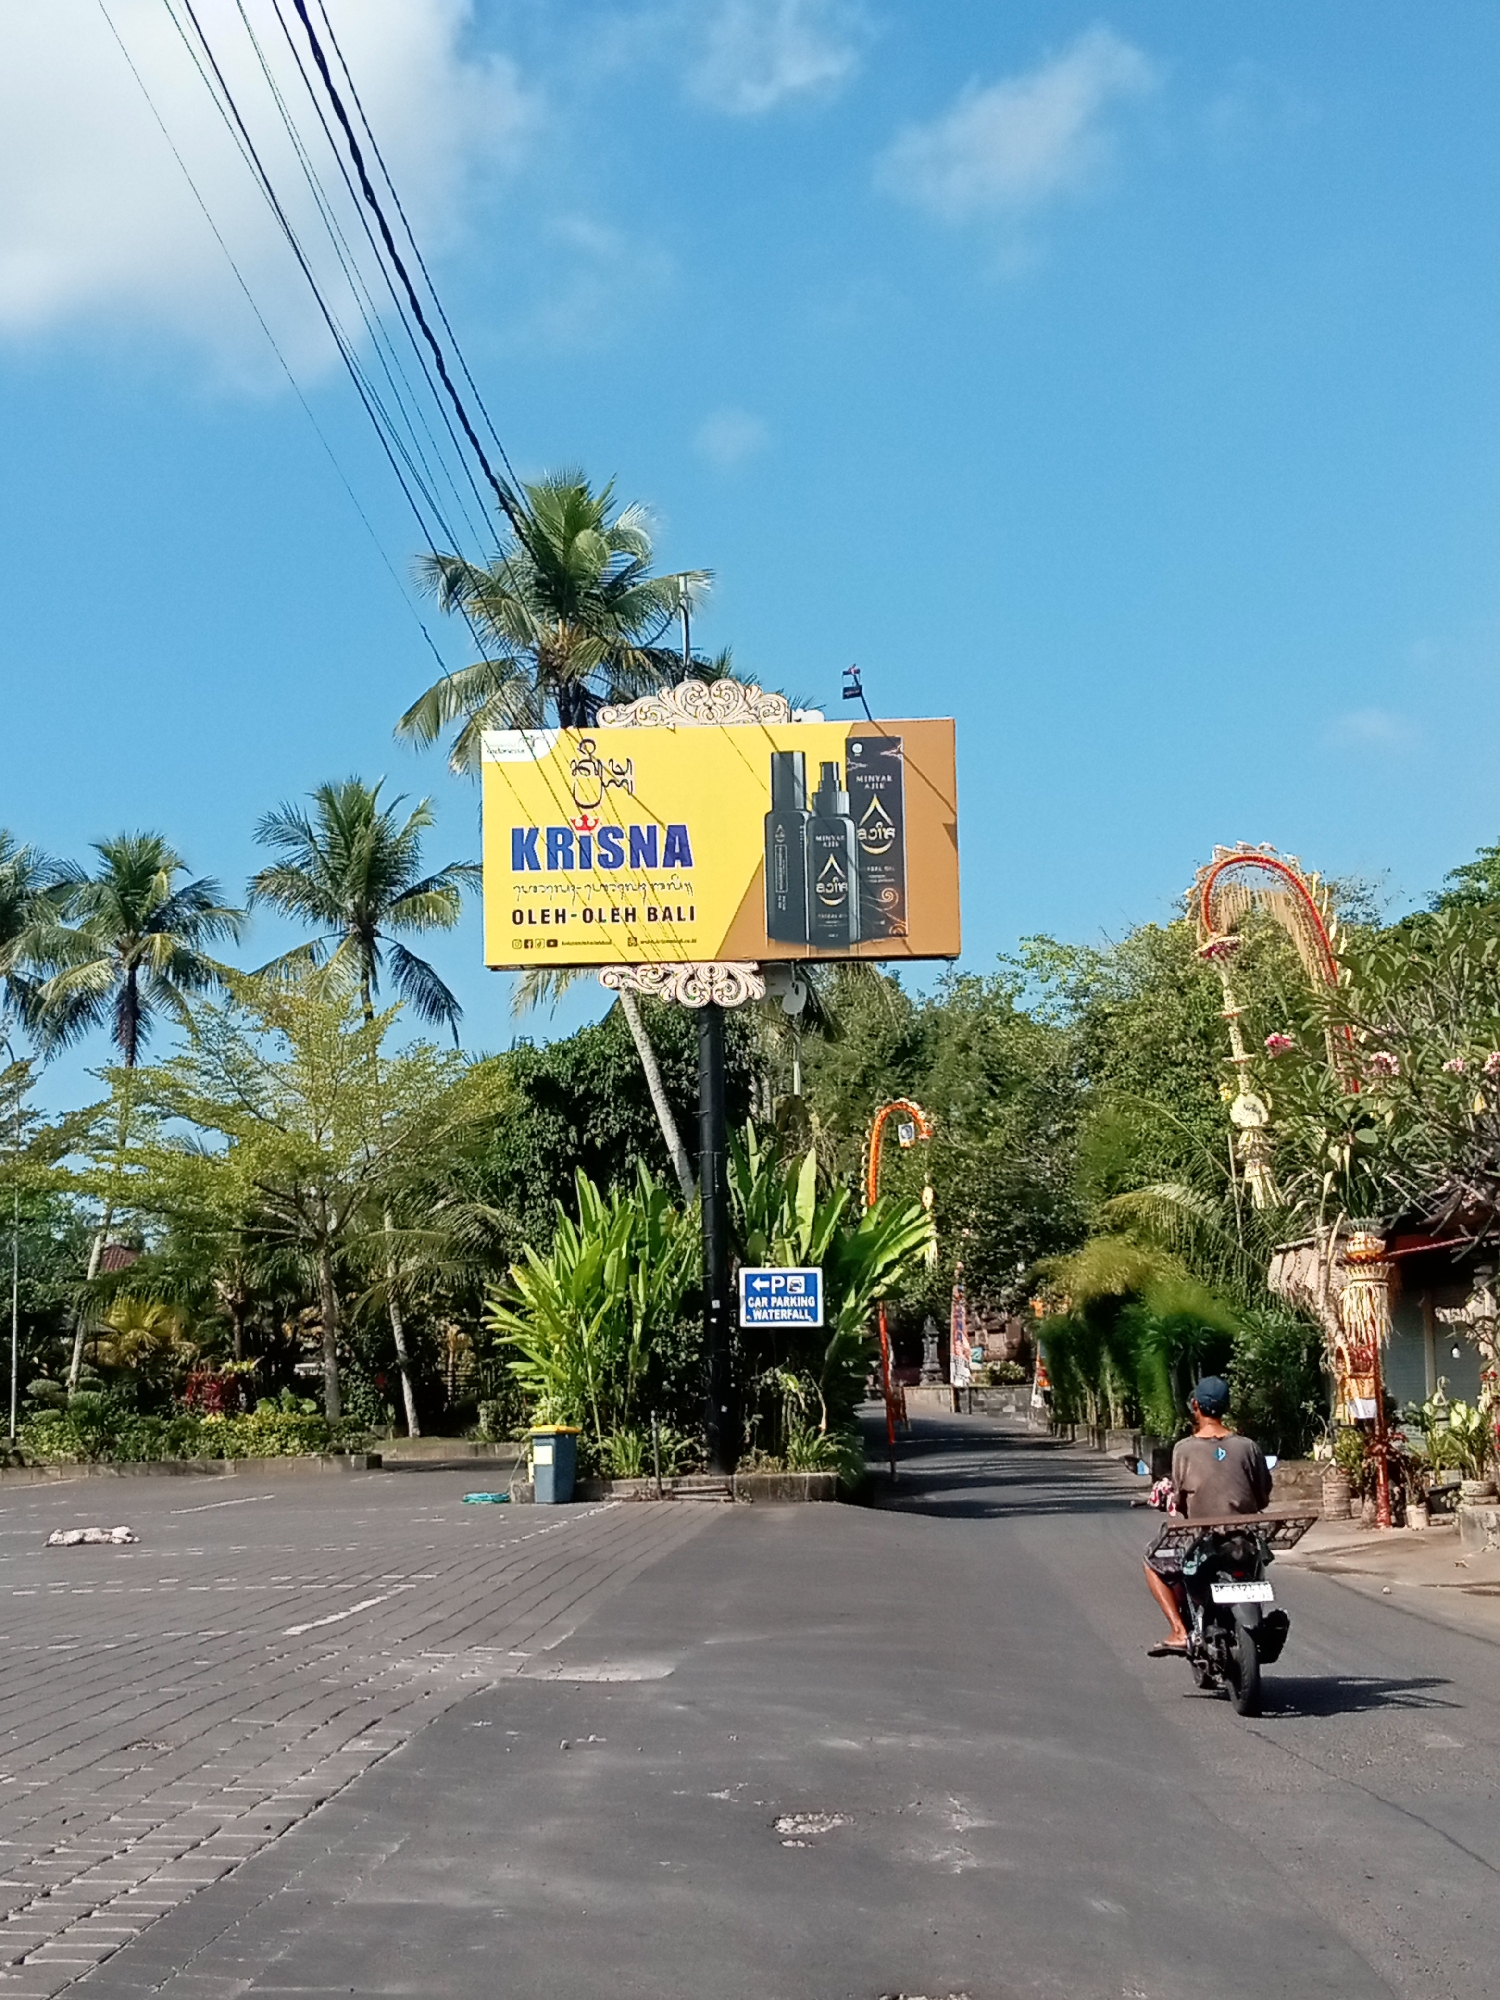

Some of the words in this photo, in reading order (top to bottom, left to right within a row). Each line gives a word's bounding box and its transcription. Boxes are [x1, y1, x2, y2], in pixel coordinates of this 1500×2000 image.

[647, 905, 695, 923] BALI
[771, 1275, 786, 1295] P
[747, 1296, 768, 1308] CAR
[771, 1295, 816, 1308] PARKING
[753, 1308, 811, 1321] WATERFALL
